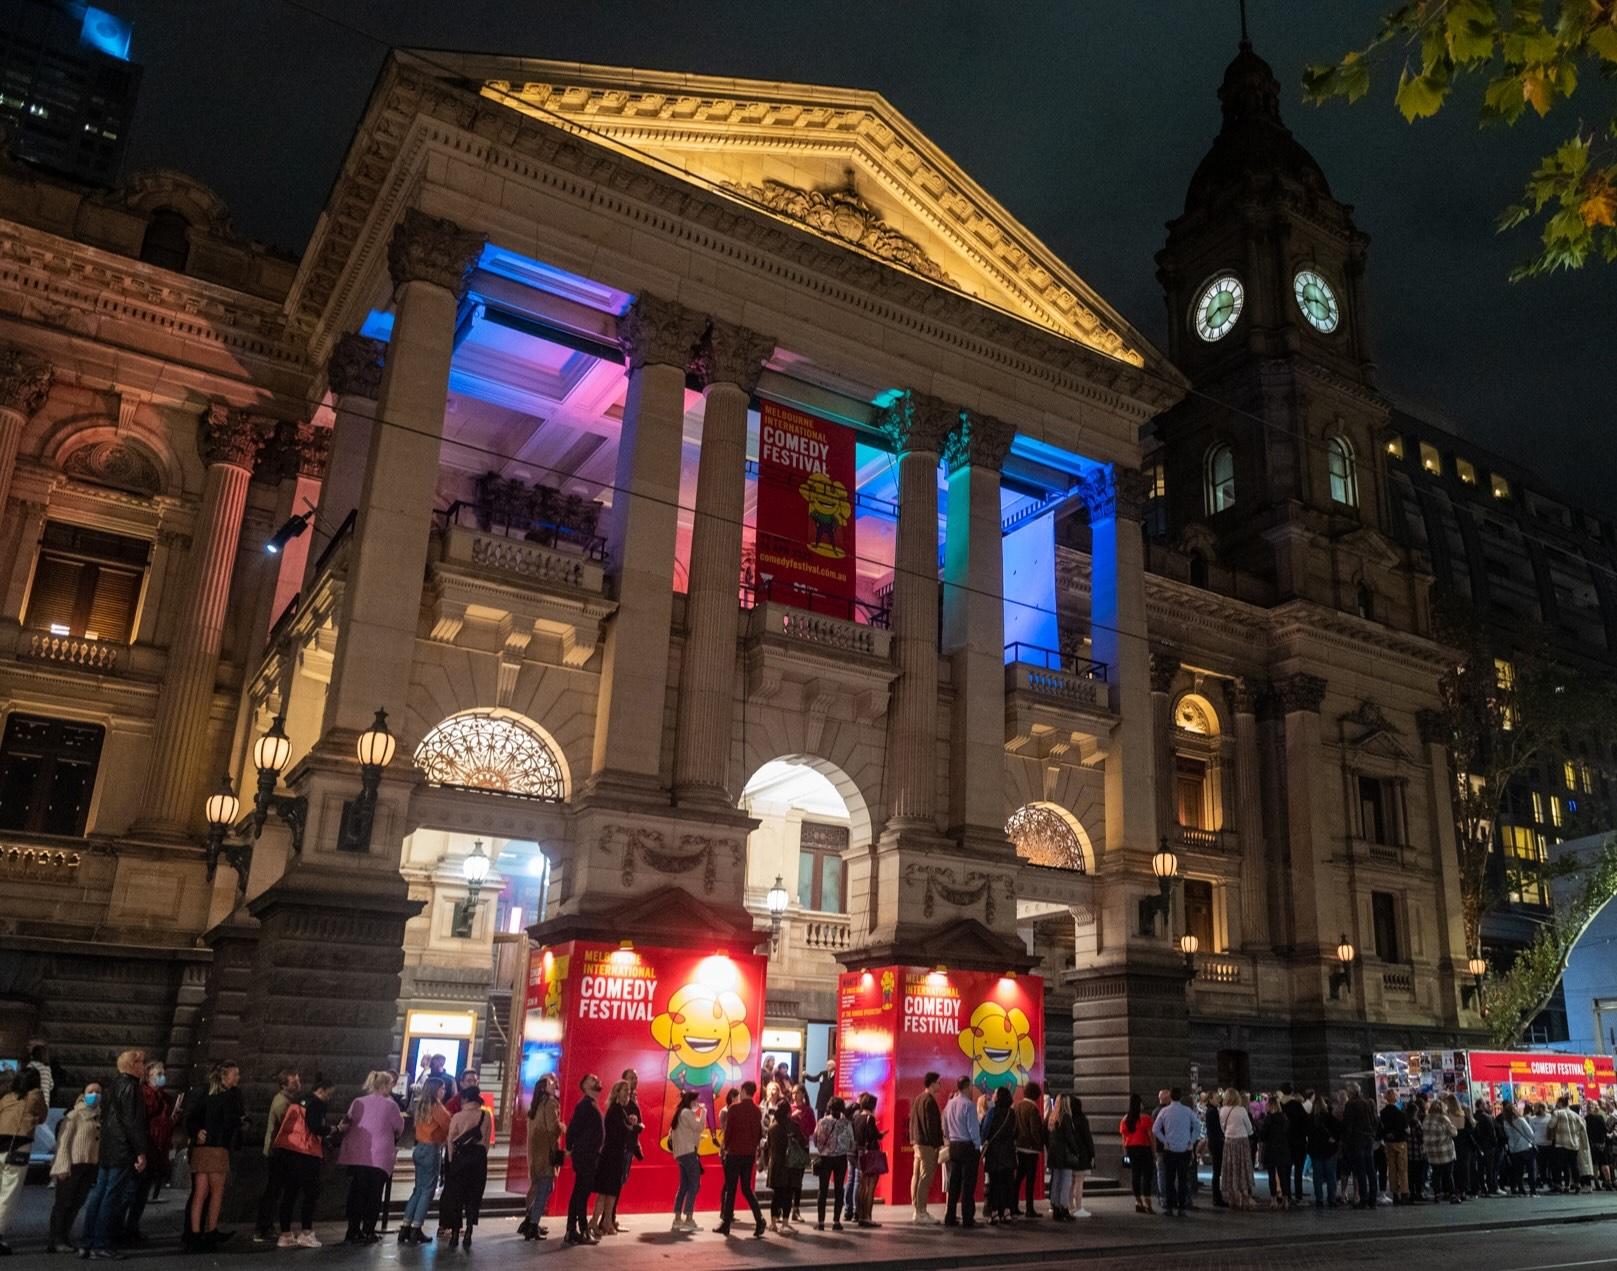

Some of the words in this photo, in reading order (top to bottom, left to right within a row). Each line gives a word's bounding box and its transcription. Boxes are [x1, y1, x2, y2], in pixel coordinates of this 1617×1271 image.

[764, 405, 814, 428] MELBOURNE
[764, 415, 828, 443] INTERNATIONAL
[763, 426, 829, 461] COMEDY
[763, 444, 830, 478] FESTIVAL
[760, 553, 847, 582] comedyfestival.com.au
[583, 963, 656, 978] INTERNATIONAL
[580, 976, 658, 1001] COMEDY
[579, 999, 655, 1022] FESTIVAL
[904, 996, 961, 1017] COMEDY
[904, 1016, 961, 1035] FESTIVAL
[1531, 1061, 1556, 1074] COMEDY
[1557, 1062, 1585, 1076] FESTIVAL
